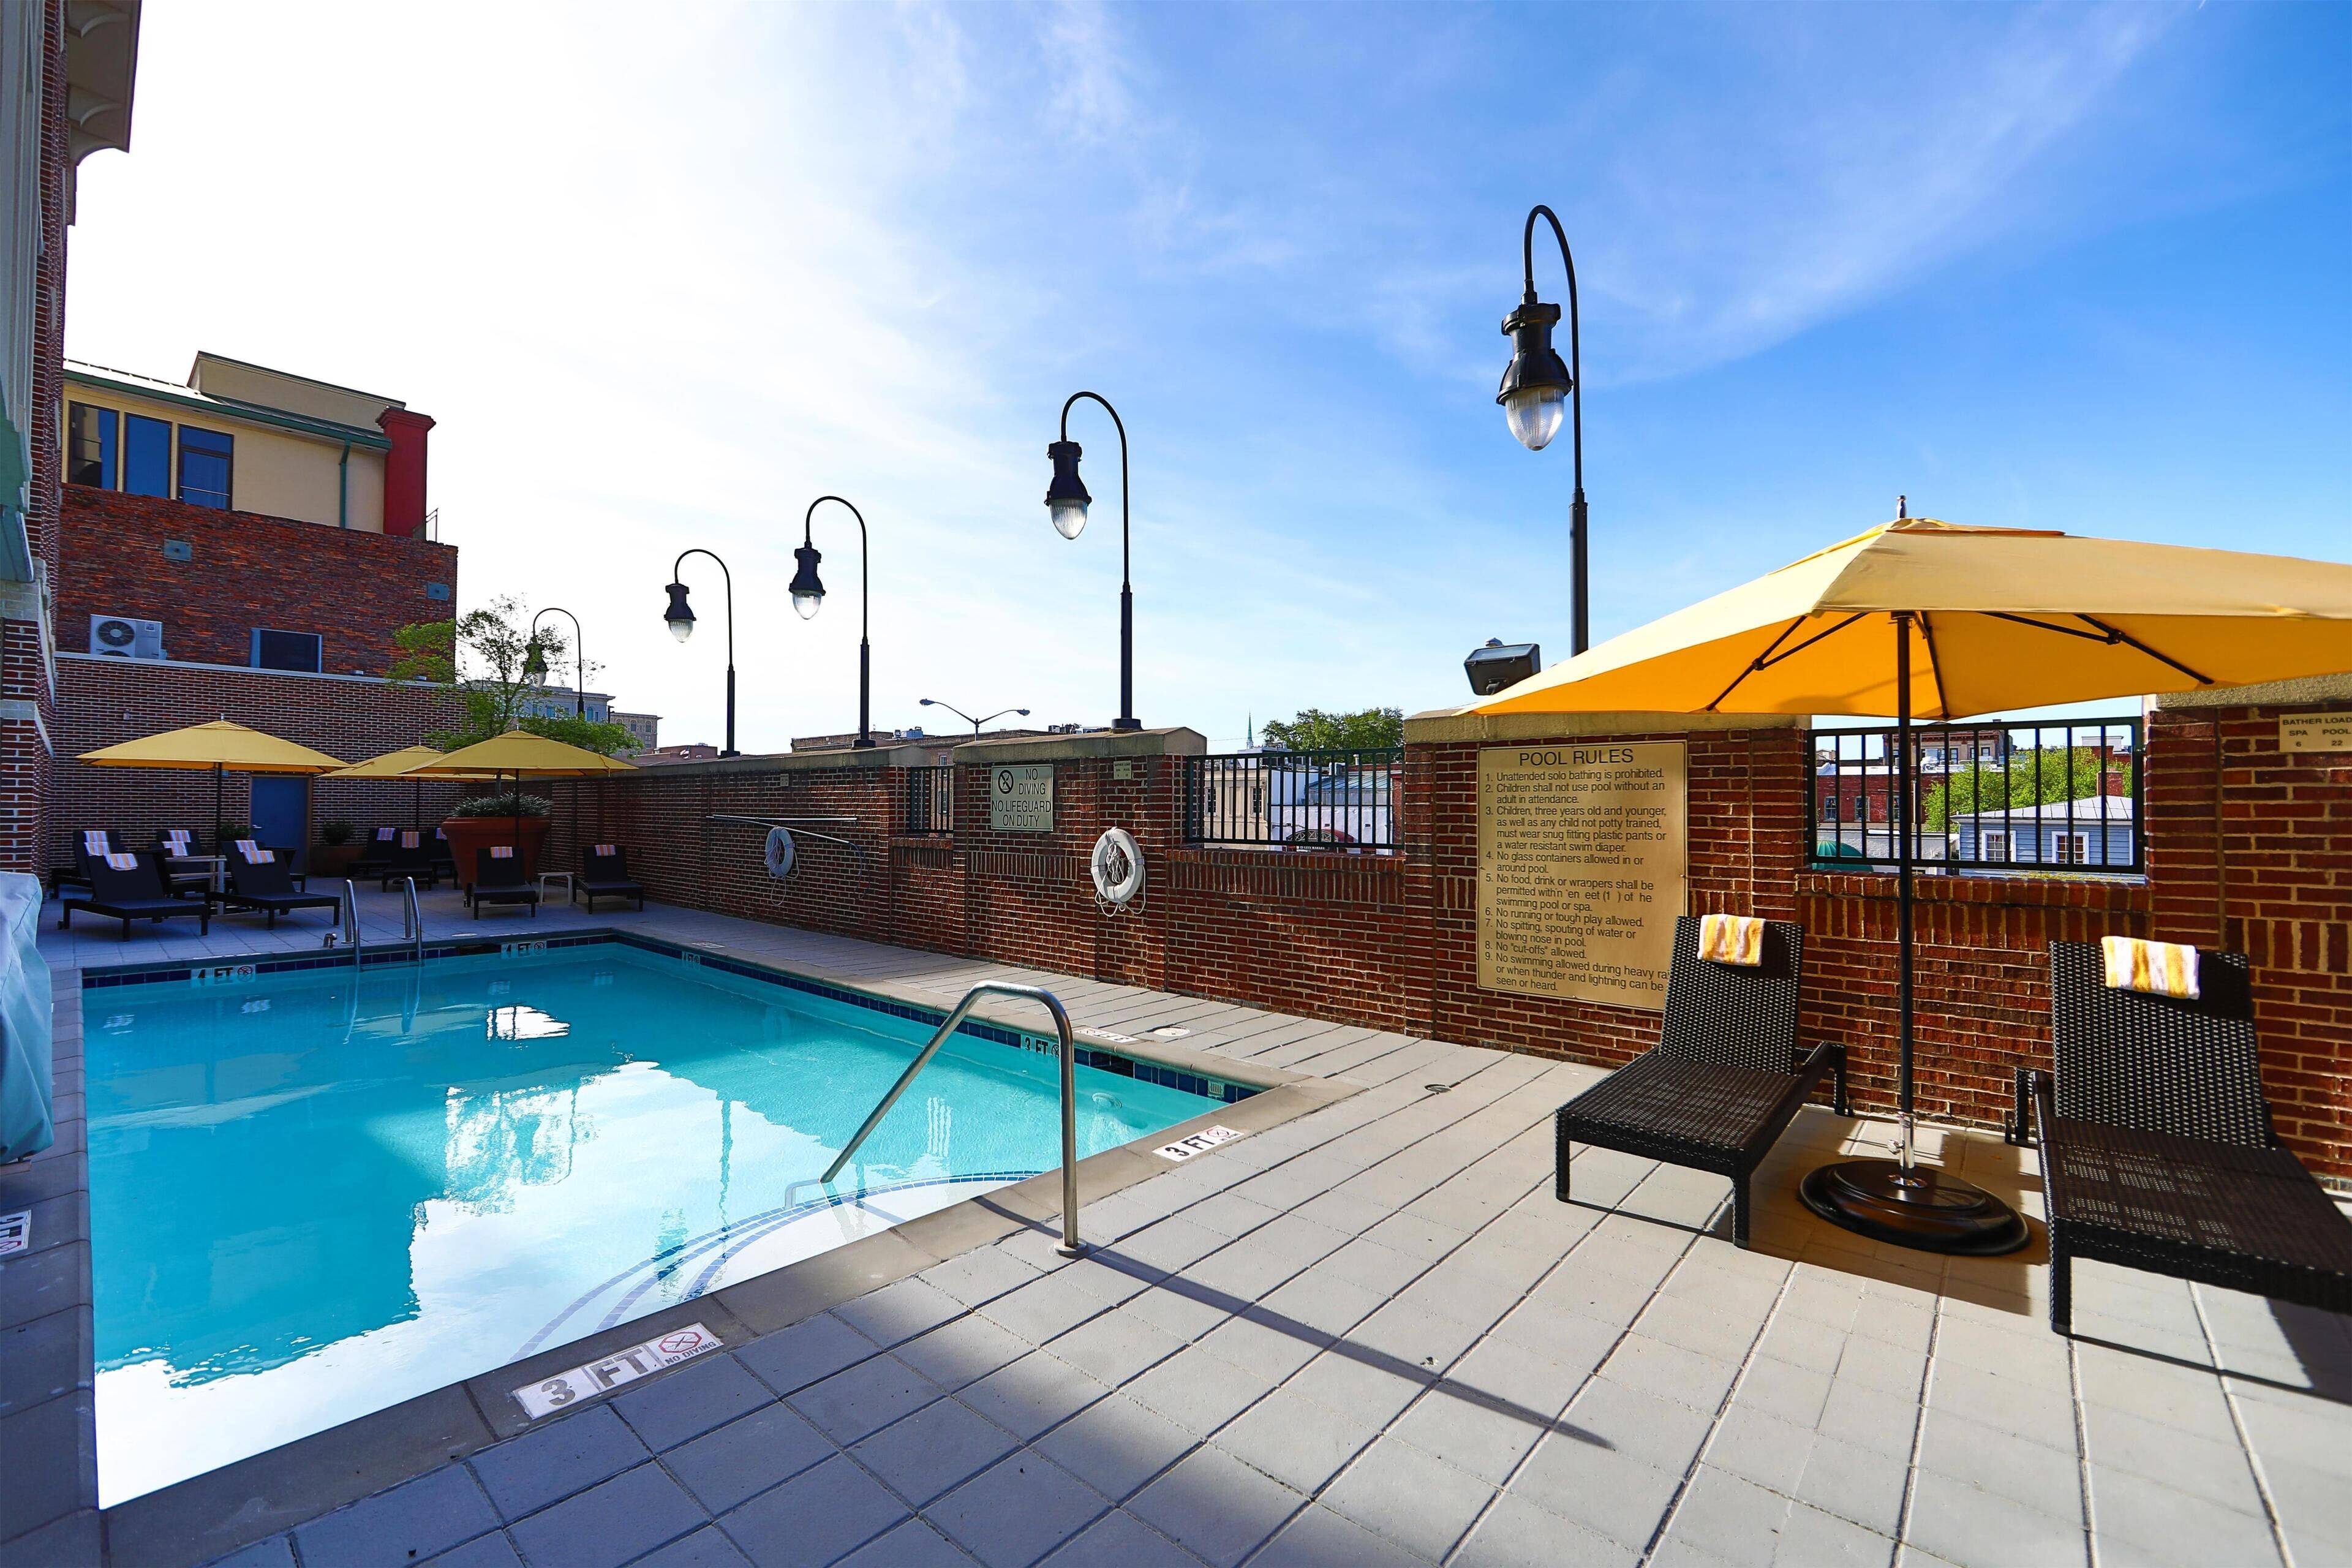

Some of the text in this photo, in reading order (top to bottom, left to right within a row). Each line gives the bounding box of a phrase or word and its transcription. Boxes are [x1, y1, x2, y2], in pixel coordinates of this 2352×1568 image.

[1519, 748, 1634, 766] POOL RULES
[1025, 768, 1038, 780] NO
[1485, 768, 1664, 782] 1. Unattended solo bathing is prohibited.
[1019, 783, 1046, 795] DIVING
[1485, 784, 1493, 793] 2.
[1496, 783, 1531, 793] Children
[1532, 783, 1553, 792] shall
[1555, 783, 1570, 792] not
[1591, 782, 1611, 793] pool
[1614, 781, 1649, 791] without
[992, 800, 1052, 813] NO LIFEGUARD
[1496, 794, 1580, 804] adult in attendance.
[1485, 805, 1667, 818] 3. Children, three years old and younger,
[1003, 814, 1040, 827] ON DUTY
[1509, 818, 1526, 827] well
[1540, 820, 1557, 829] any
[1558, 818, 1580, 827] child
[1581, 818, 1597, 828] not
[1599, 818, 1623, 830] potty
[1496, 829, 1518, 838] must
[1542, 831, 1564, 841] snug
[1566, 829, 1591, 842] fitting
[1593, 830, 1623, 842] plastic
[1625, 831, 1653, 842] pants
[1656, 832, 1667, 841] or
[1504, 841, 1528, 850] water
[1529, 841, 1567, 851] resistant
[1569, 842, 1593, 851] swim
[1595, 842, 1627, 854] diaper.
[1485, 851, 1645, 865] 4. No glass containers allowed in or
[1496, 864, 1549, 875] around pool.
[1485, 873, 1494, 883] 5.
[1496, 873, 1509, 883] No
[1534, 875, 1556, 886] drink
[1557, 878, 1567, 886] or
[1615, 879, 1638, 889] shall
[1640, 880, 1654, 891] be
[1496, 886, 1536, 896] permitted
[1566, 889, 1580, 899] en
[1585, 891, 1600, 900] eet
[1624, 892, 1634, 902] of
[1639, 892, 1653, 903] he
[1496, 897, 1537, 910] swimming
[1539, 900, 1559, 910] pool
[1573, 903, 1593, 913] spa.
[1485, 907, 1493, 916] 6.
[1496, 907, 1509, 917] No
[1510, 910, 1542, 922] running
[1583, 914, 1603, 926] play
[1605, 916, 1644, 927] allowed.
[1485, 918, 1493, 927] 7.
[1496, 919, 1509, 929] No
[1544, 924, 1583, 937] spouting
[1585, 926, 1595, 936] of
[1597, 928, 1624, 938] water
[1626, 930, 1637, 939] or
[1496, 930, 1587, 947] blowing nose in pool.
[1485, 940, 1493, 950] 8.
[1496, 941, 1509, 951] No
[1550, 947, 1587, 959] allowed.
[1485, 951, 1493, 961] 9.
[1496, 952, 1509, 963] No
[1510, 956, 1553, 969] swimming
[1555, 959, 1590, 971] allowed
[1592, 962, 1621, 976] during
[1624, 965, 1654, 980] heavy
[214, 967, 233, 981] FT
[1506, 966, 1530, 976] when
[1532, 968, 1566, 980] thunder
[1568, 973, 1586, 982] and
[1588, 973, 1626, 990] lightning
[1629, 979, 1648, 990] can
[1650, 980, 1664, 992] be
[1496, 976, 1558, 992] seen or heard.
[1025, 1036, 1049, 1055] 3 FT
[1164, 1147, 1190, 1157] 3
[1181, 1135, 1216, 1150] FT
[665, 1341, 717, 1365] NO DIVING
[541, 1348, 650, 1406] 3 FT
